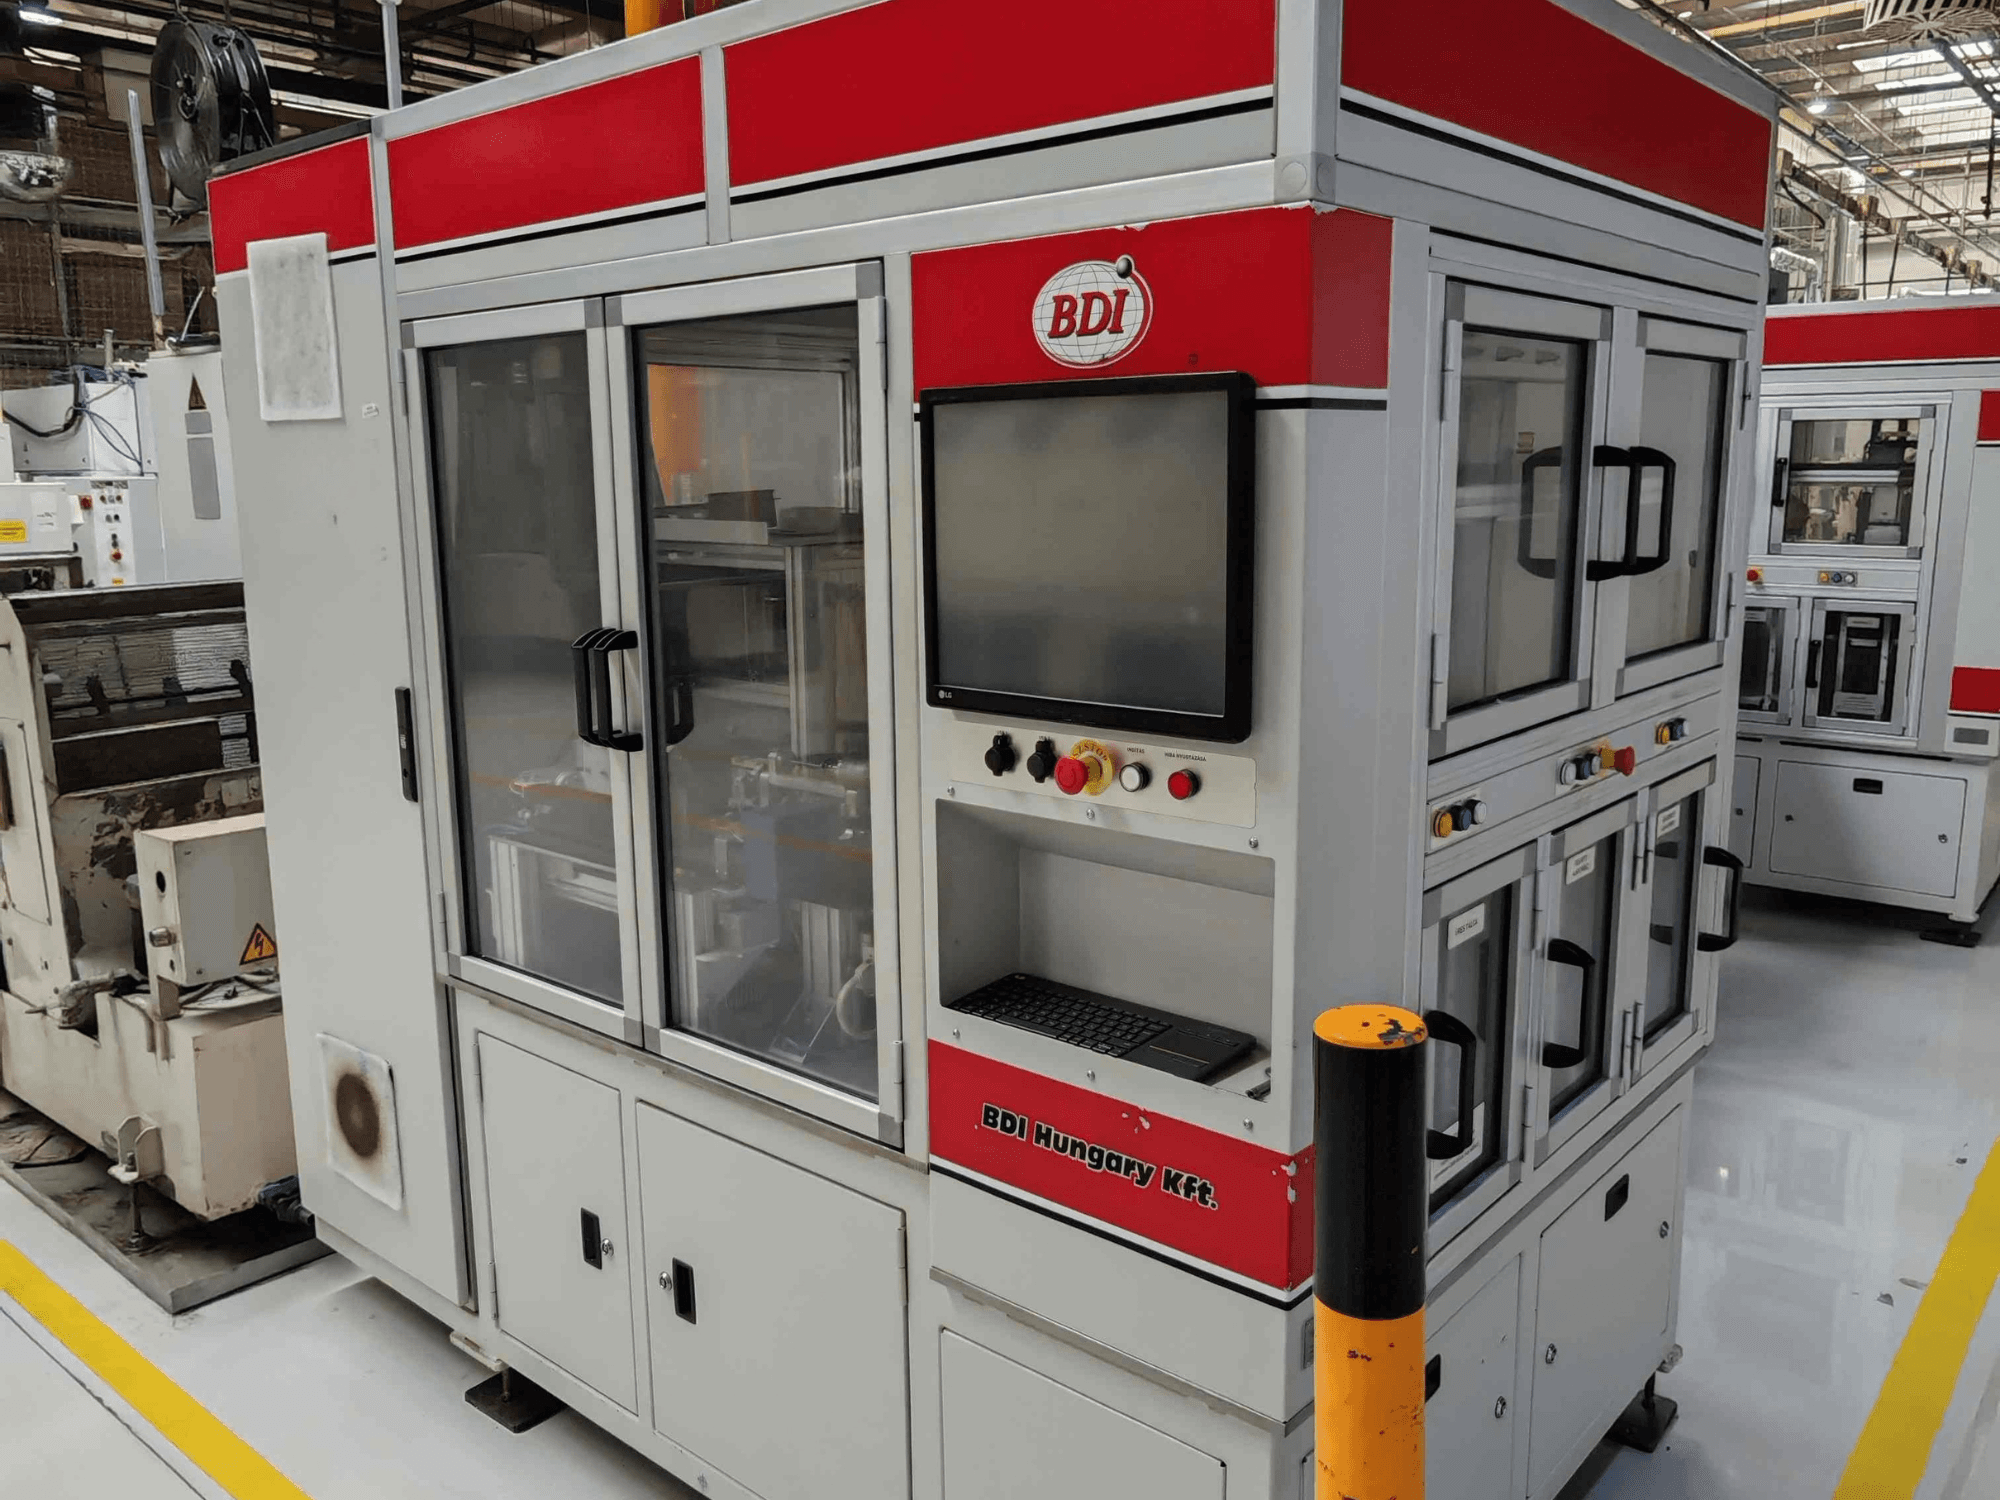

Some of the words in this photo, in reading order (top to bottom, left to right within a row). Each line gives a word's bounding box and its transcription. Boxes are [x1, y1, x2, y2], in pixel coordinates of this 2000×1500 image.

[1047, 289, 1130, 339] BDI
[981, 1102, 1028, 1141] BDI
[1033, 1121, 1157, 1189] Hungary
[1161, 1166, 1219, 1211] Kft.
